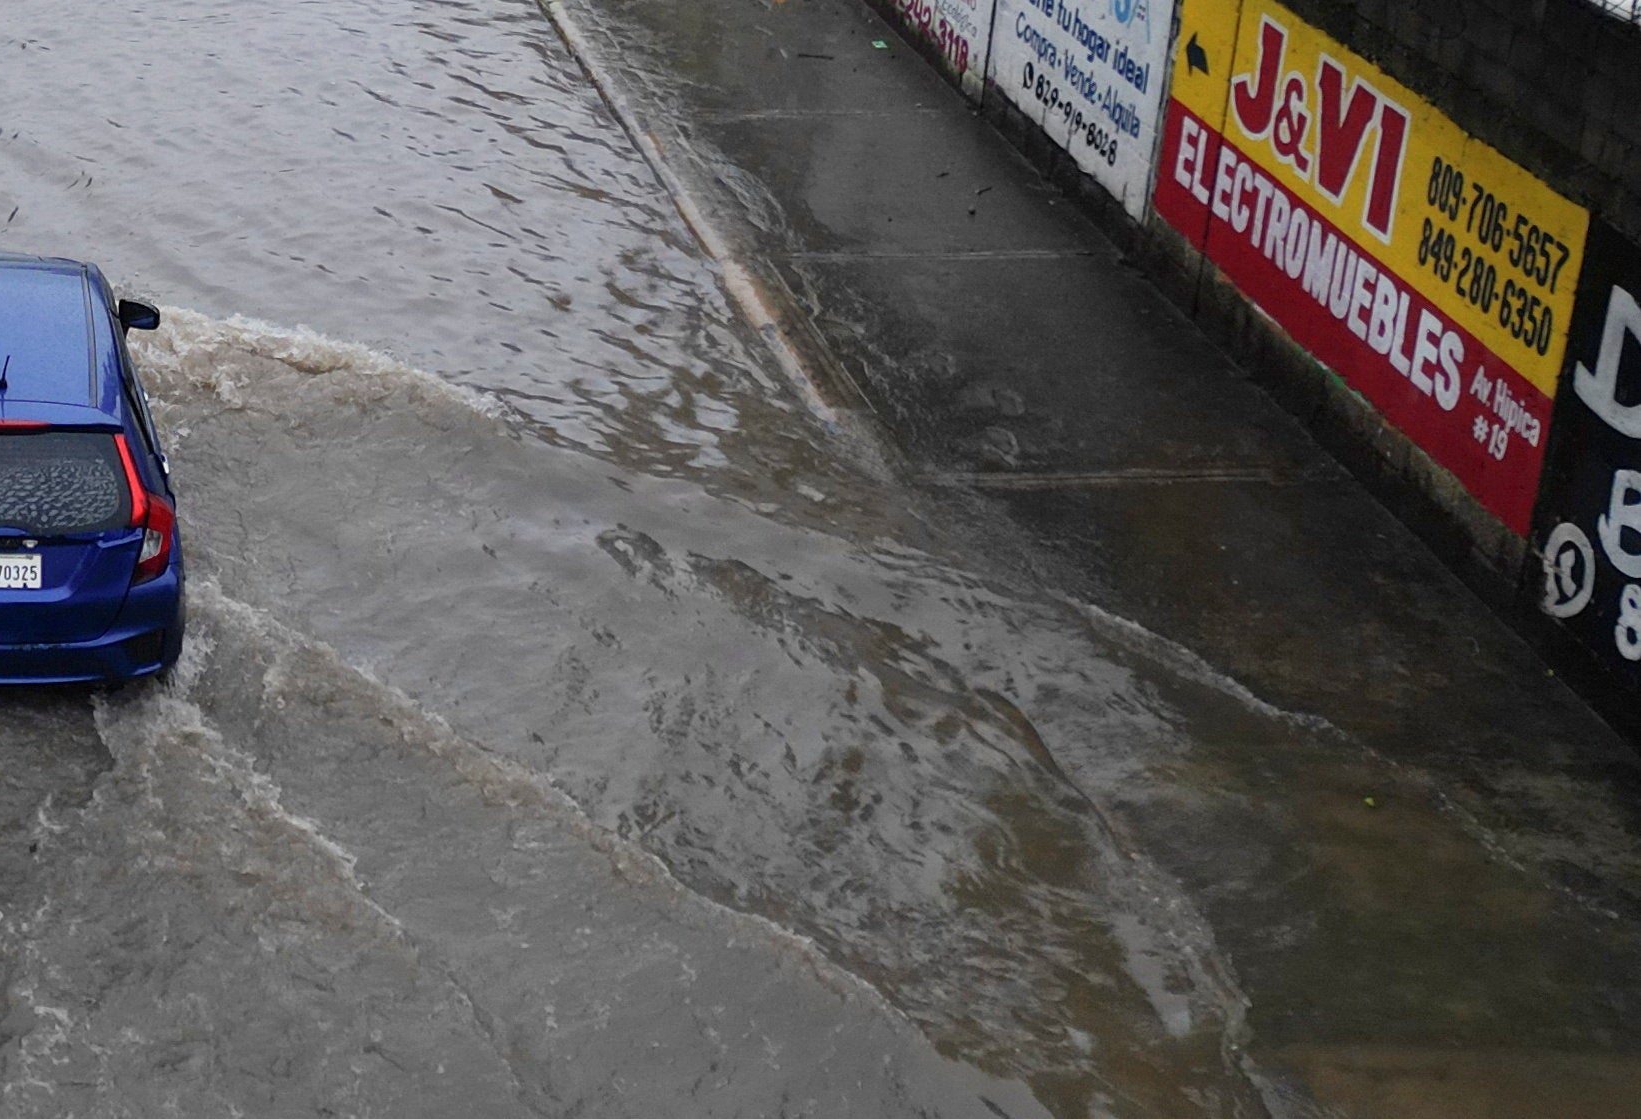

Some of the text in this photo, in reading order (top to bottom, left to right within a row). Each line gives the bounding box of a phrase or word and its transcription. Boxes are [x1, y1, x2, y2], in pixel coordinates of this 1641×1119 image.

[1015, 12, 1141, 140] Compra Vende Alquila
[1073, 9, 1112, 64] hogar
[1112, 43, 1150, 95] ideal
[1034, 73, 1118, 167] 829-919-8028
[1231, 13, 1411, 245] J&VI
[1174, 114, 1466, 412] ELECTROMUEBLES
[1417, 216, 1553, 357] 849-280-6350
[1427, 155, 1570, 295] 809-706-5657
[1469, 365, 1491, 407] Av.
